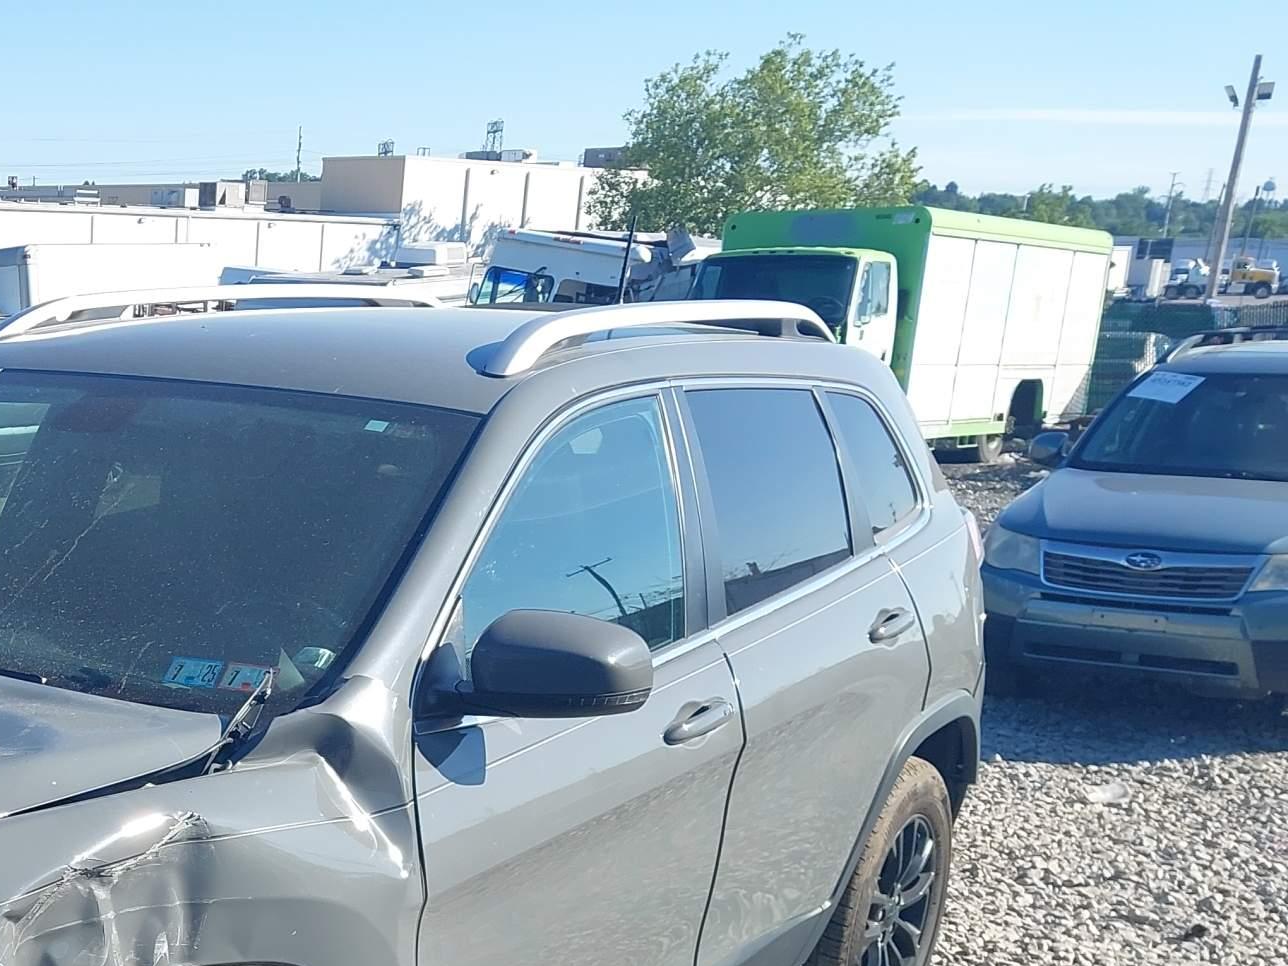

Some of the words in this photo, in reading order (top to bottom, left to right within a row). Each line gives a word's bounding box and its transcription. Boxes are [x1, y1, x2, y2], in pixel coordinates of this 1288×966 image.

[171, 664, 185, 681] 7
[200, 664, 220, 683] 25
[228, 669, 241, 686] 7
